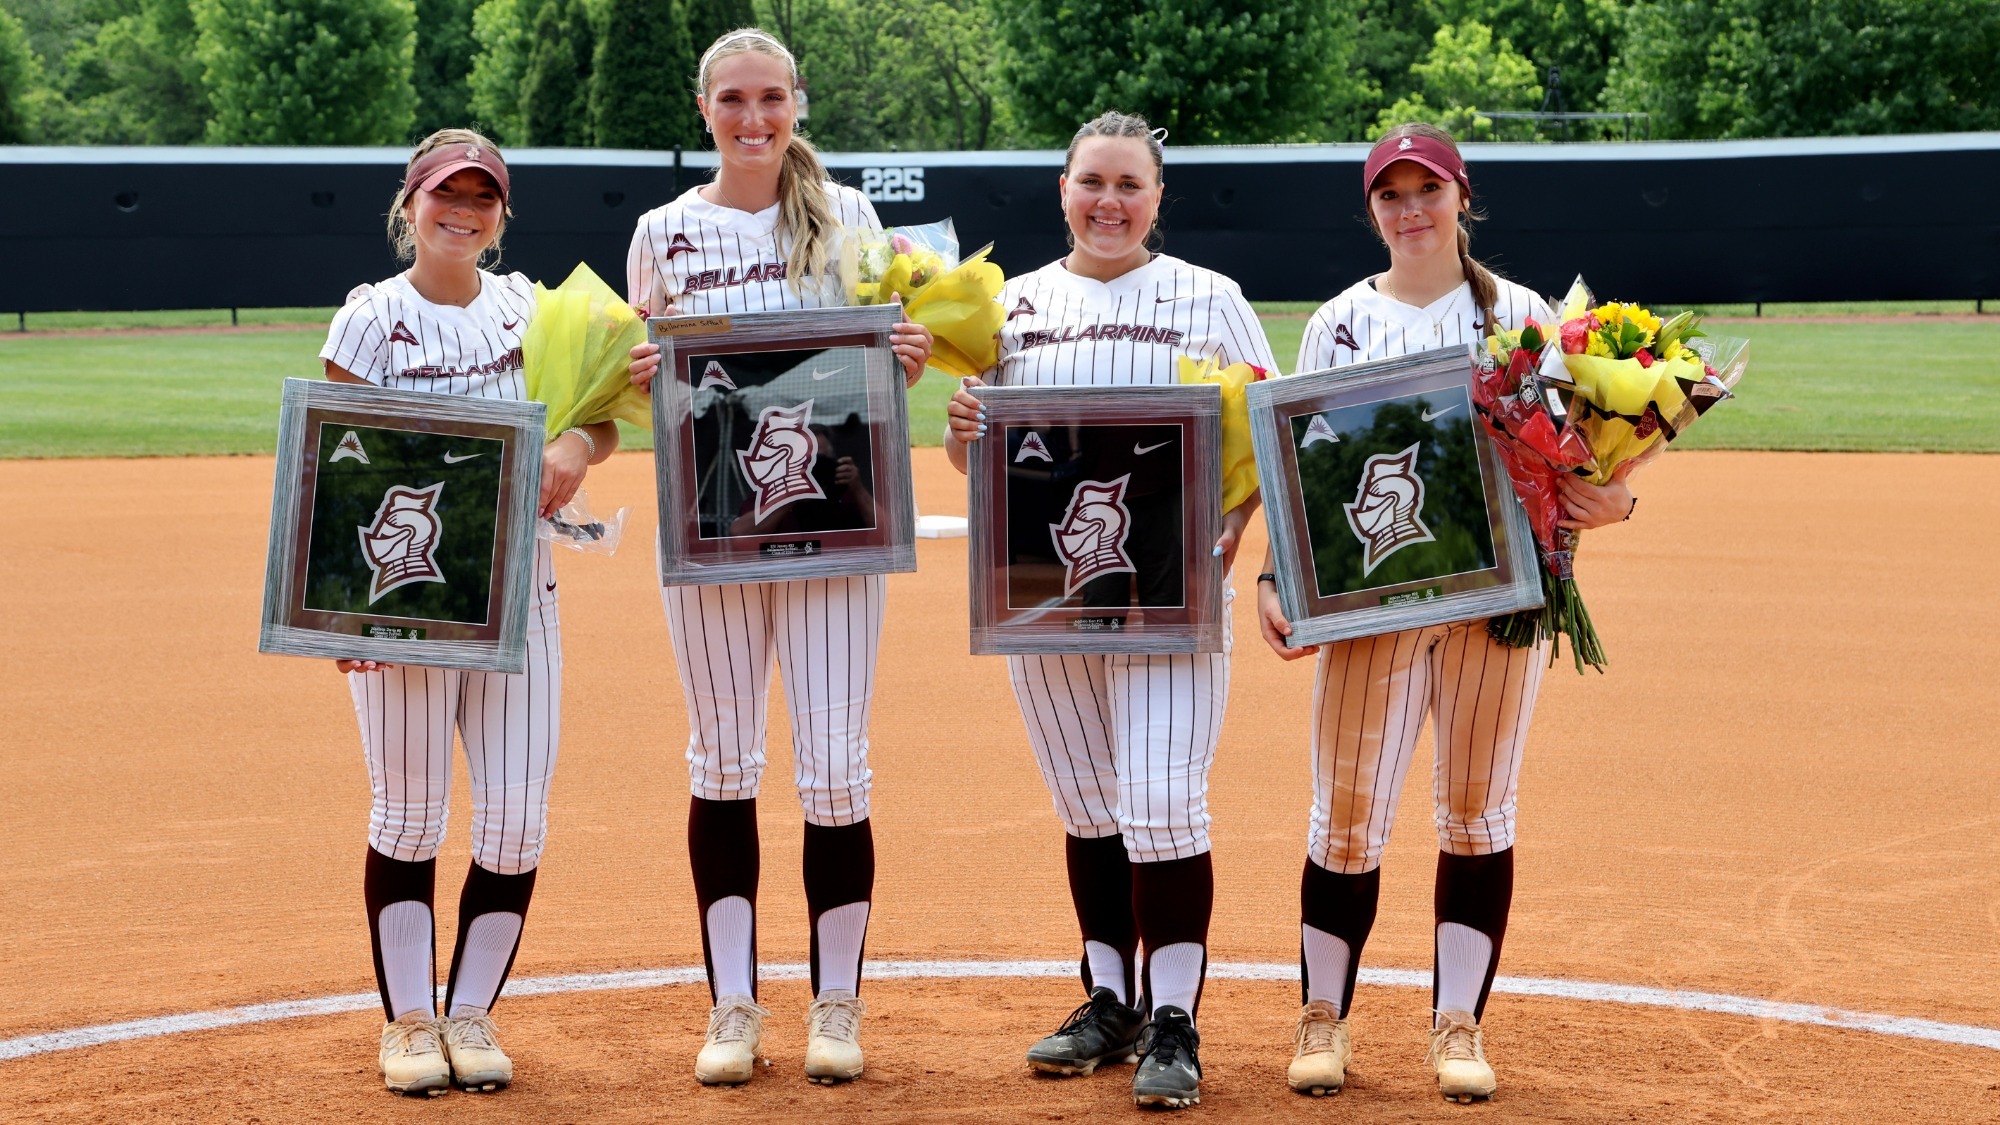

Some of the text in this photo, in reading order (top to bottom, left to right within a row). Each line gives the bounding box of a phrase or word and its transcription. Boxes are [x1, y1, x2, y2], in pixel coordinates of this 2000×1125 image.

[861, 167, 925, 202] 225
[681, 261, 837, 295] BELLAR
[1021, 323, 1185, 350] BELLARMINE
